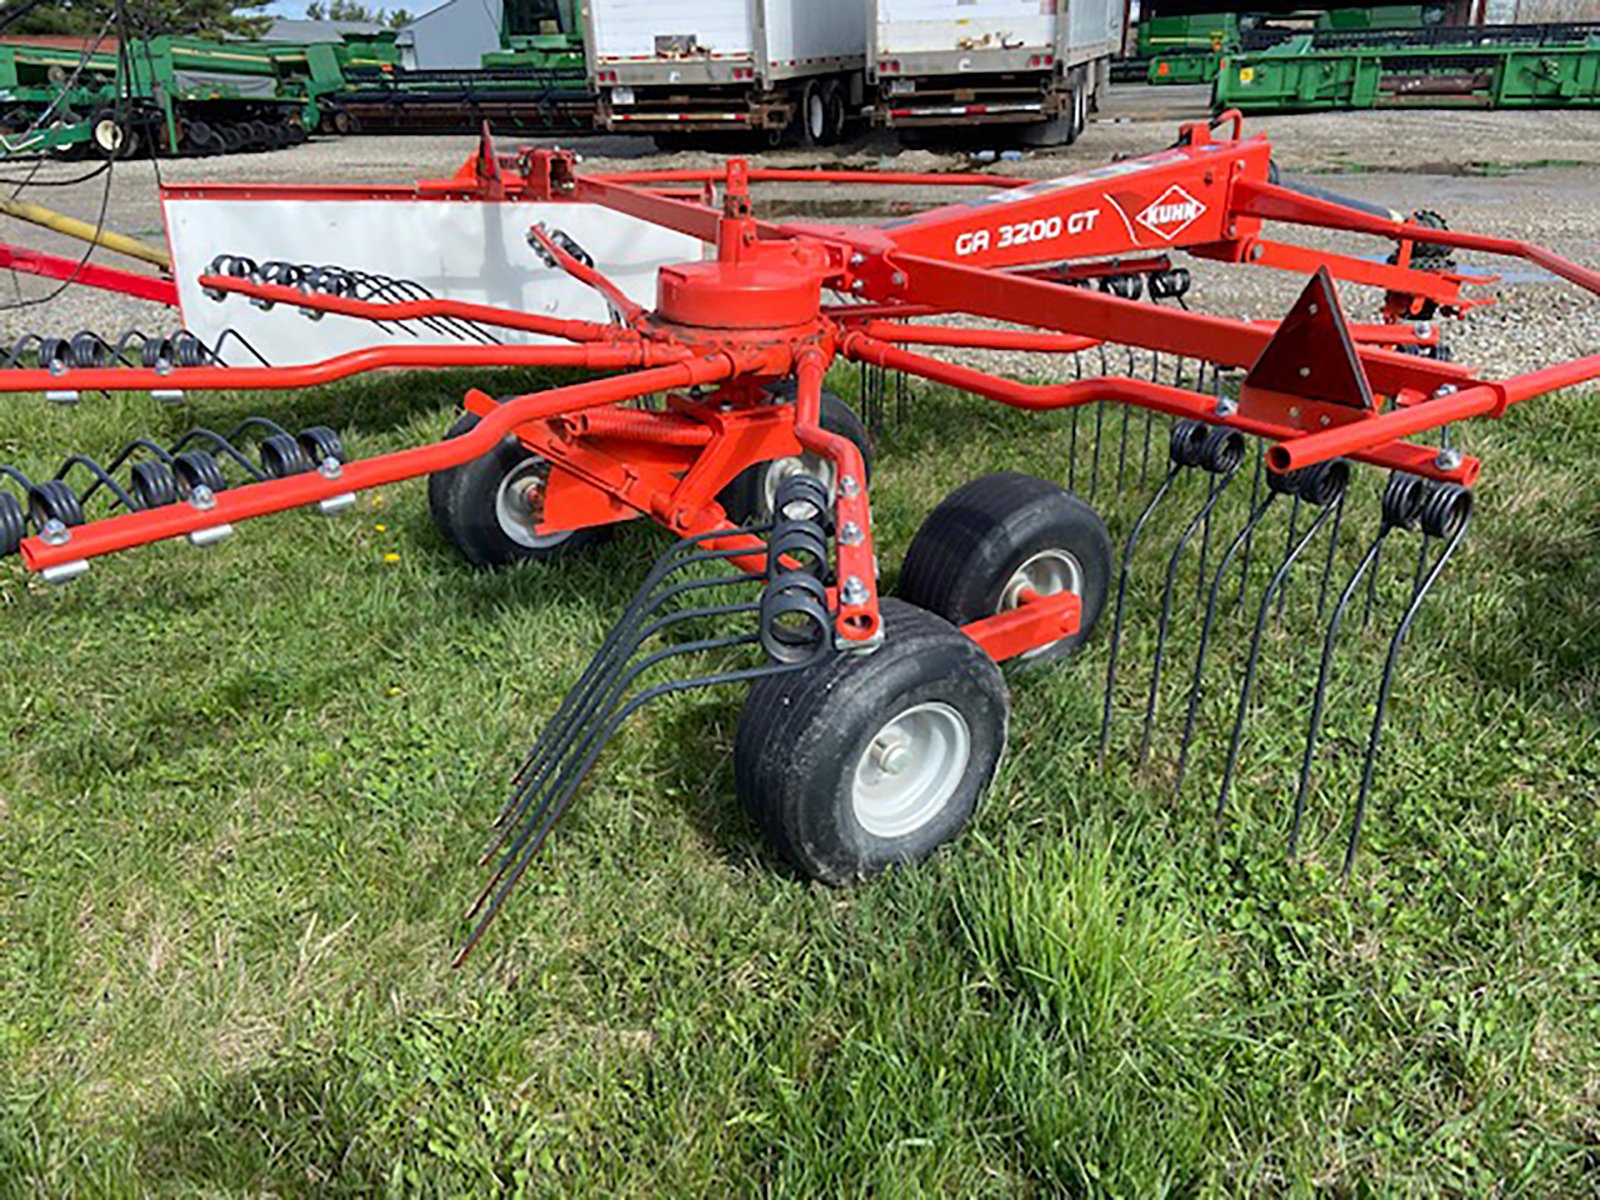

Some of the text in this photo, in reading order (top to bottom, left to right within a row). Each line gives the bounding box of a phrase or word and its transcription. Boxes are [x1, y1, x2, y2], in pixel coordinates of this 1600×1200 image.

[1146, 202, 1198, 225] KUHN
[955, 209, 1100, 255] GA 3200 GT
